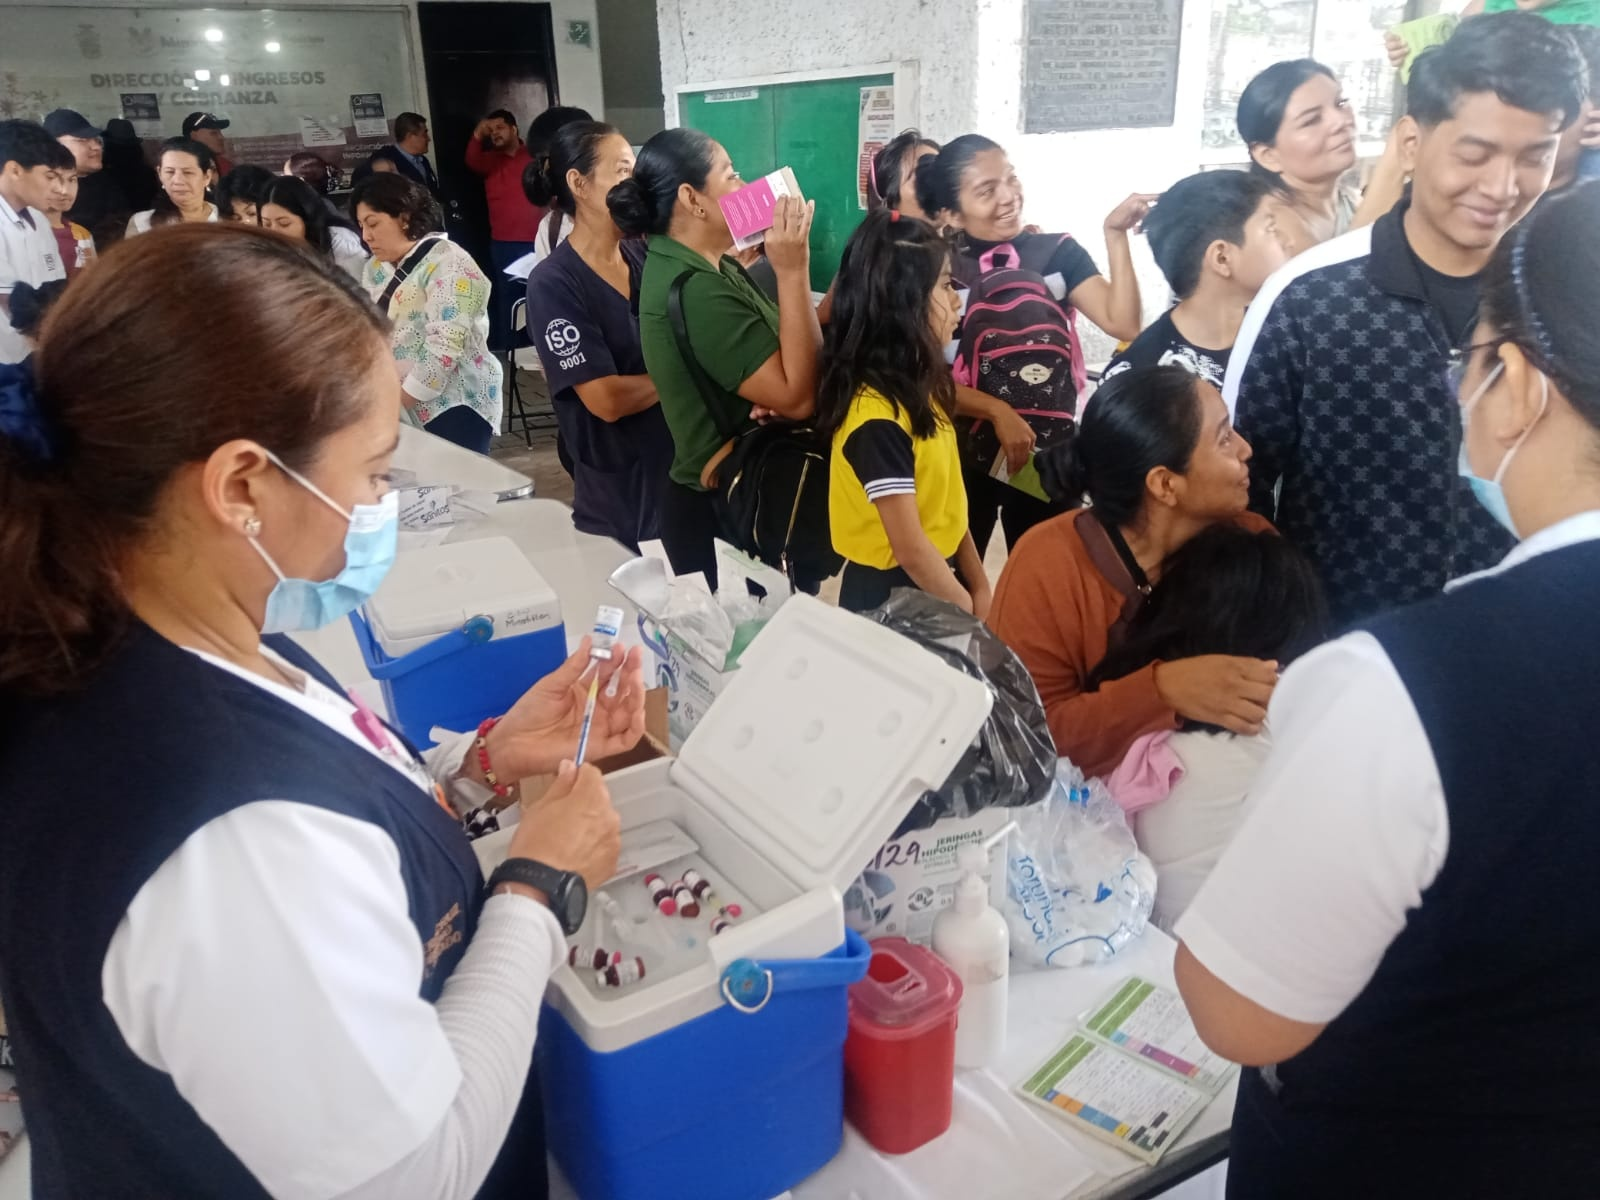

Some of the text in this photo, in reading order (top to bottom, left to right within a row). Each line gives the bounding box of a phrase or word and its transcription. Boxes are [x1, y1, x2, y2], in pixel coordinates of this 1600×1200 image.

[233, 71, 325, 86] INGRESOS
[170, 91, 278, 106] COBRANZA
[545, 325, 581, 351] ISO
[559, 351, 587, 370] 9001
[936, 829, 983, 847] JERINGAS
